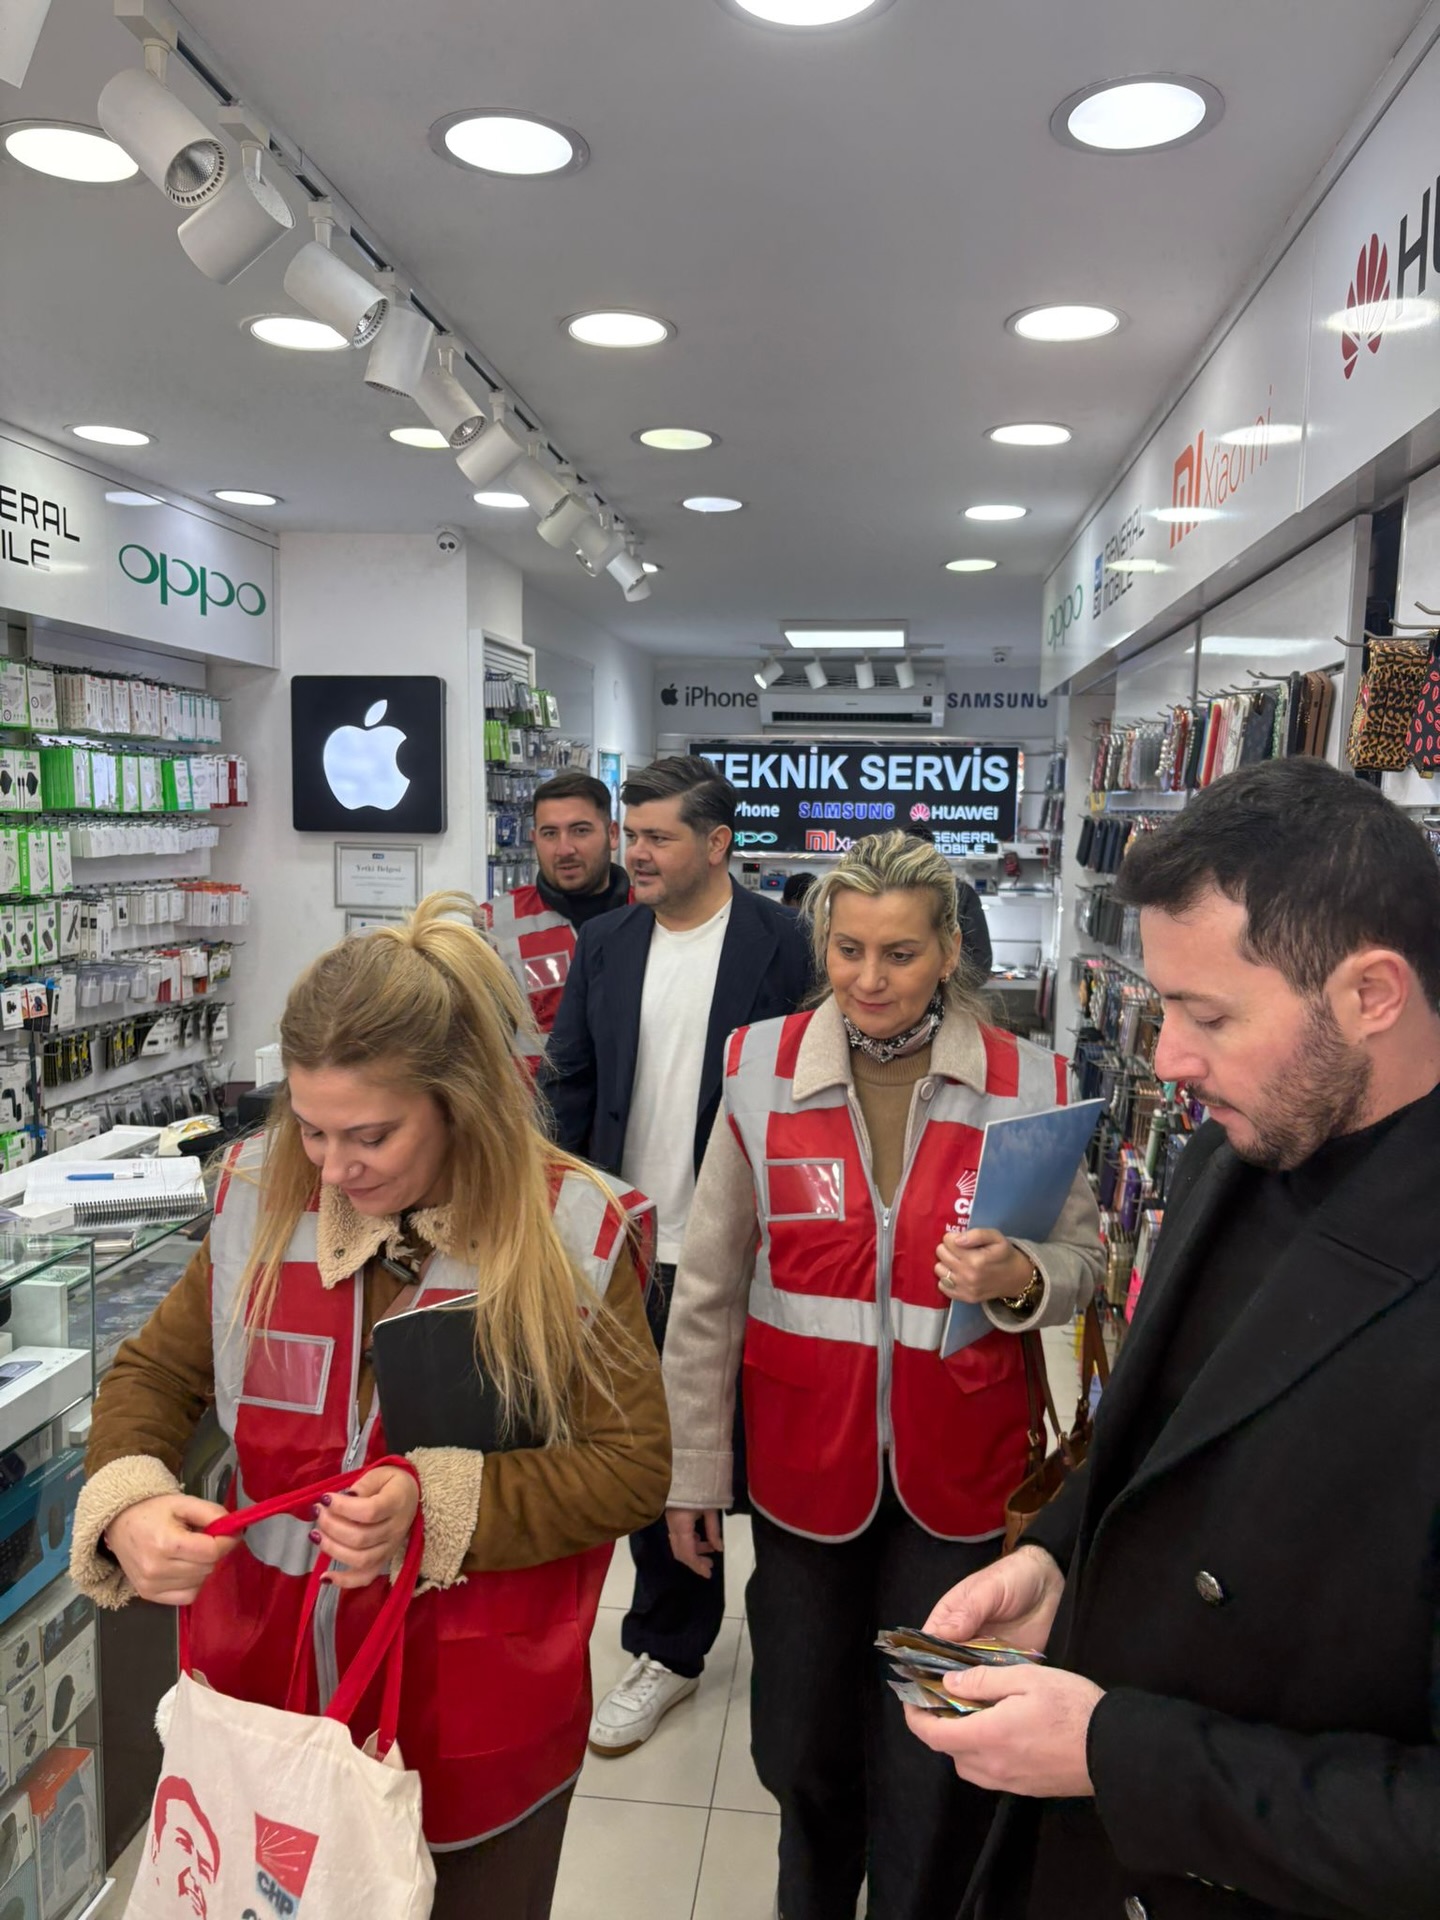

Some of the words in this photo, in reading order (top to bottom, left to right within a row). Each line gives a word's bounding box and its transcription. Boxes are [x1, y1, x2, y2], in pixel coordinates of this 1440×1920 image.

[685, 686, 758, 709] iPhone
[947, 692, 1048, 709] SAMSUNG
[859, 747, 1010, 792] SERVİS
[799, 802, 896, 820] SAMSUNG
[931, 805, 999, 820] HUAWEI
